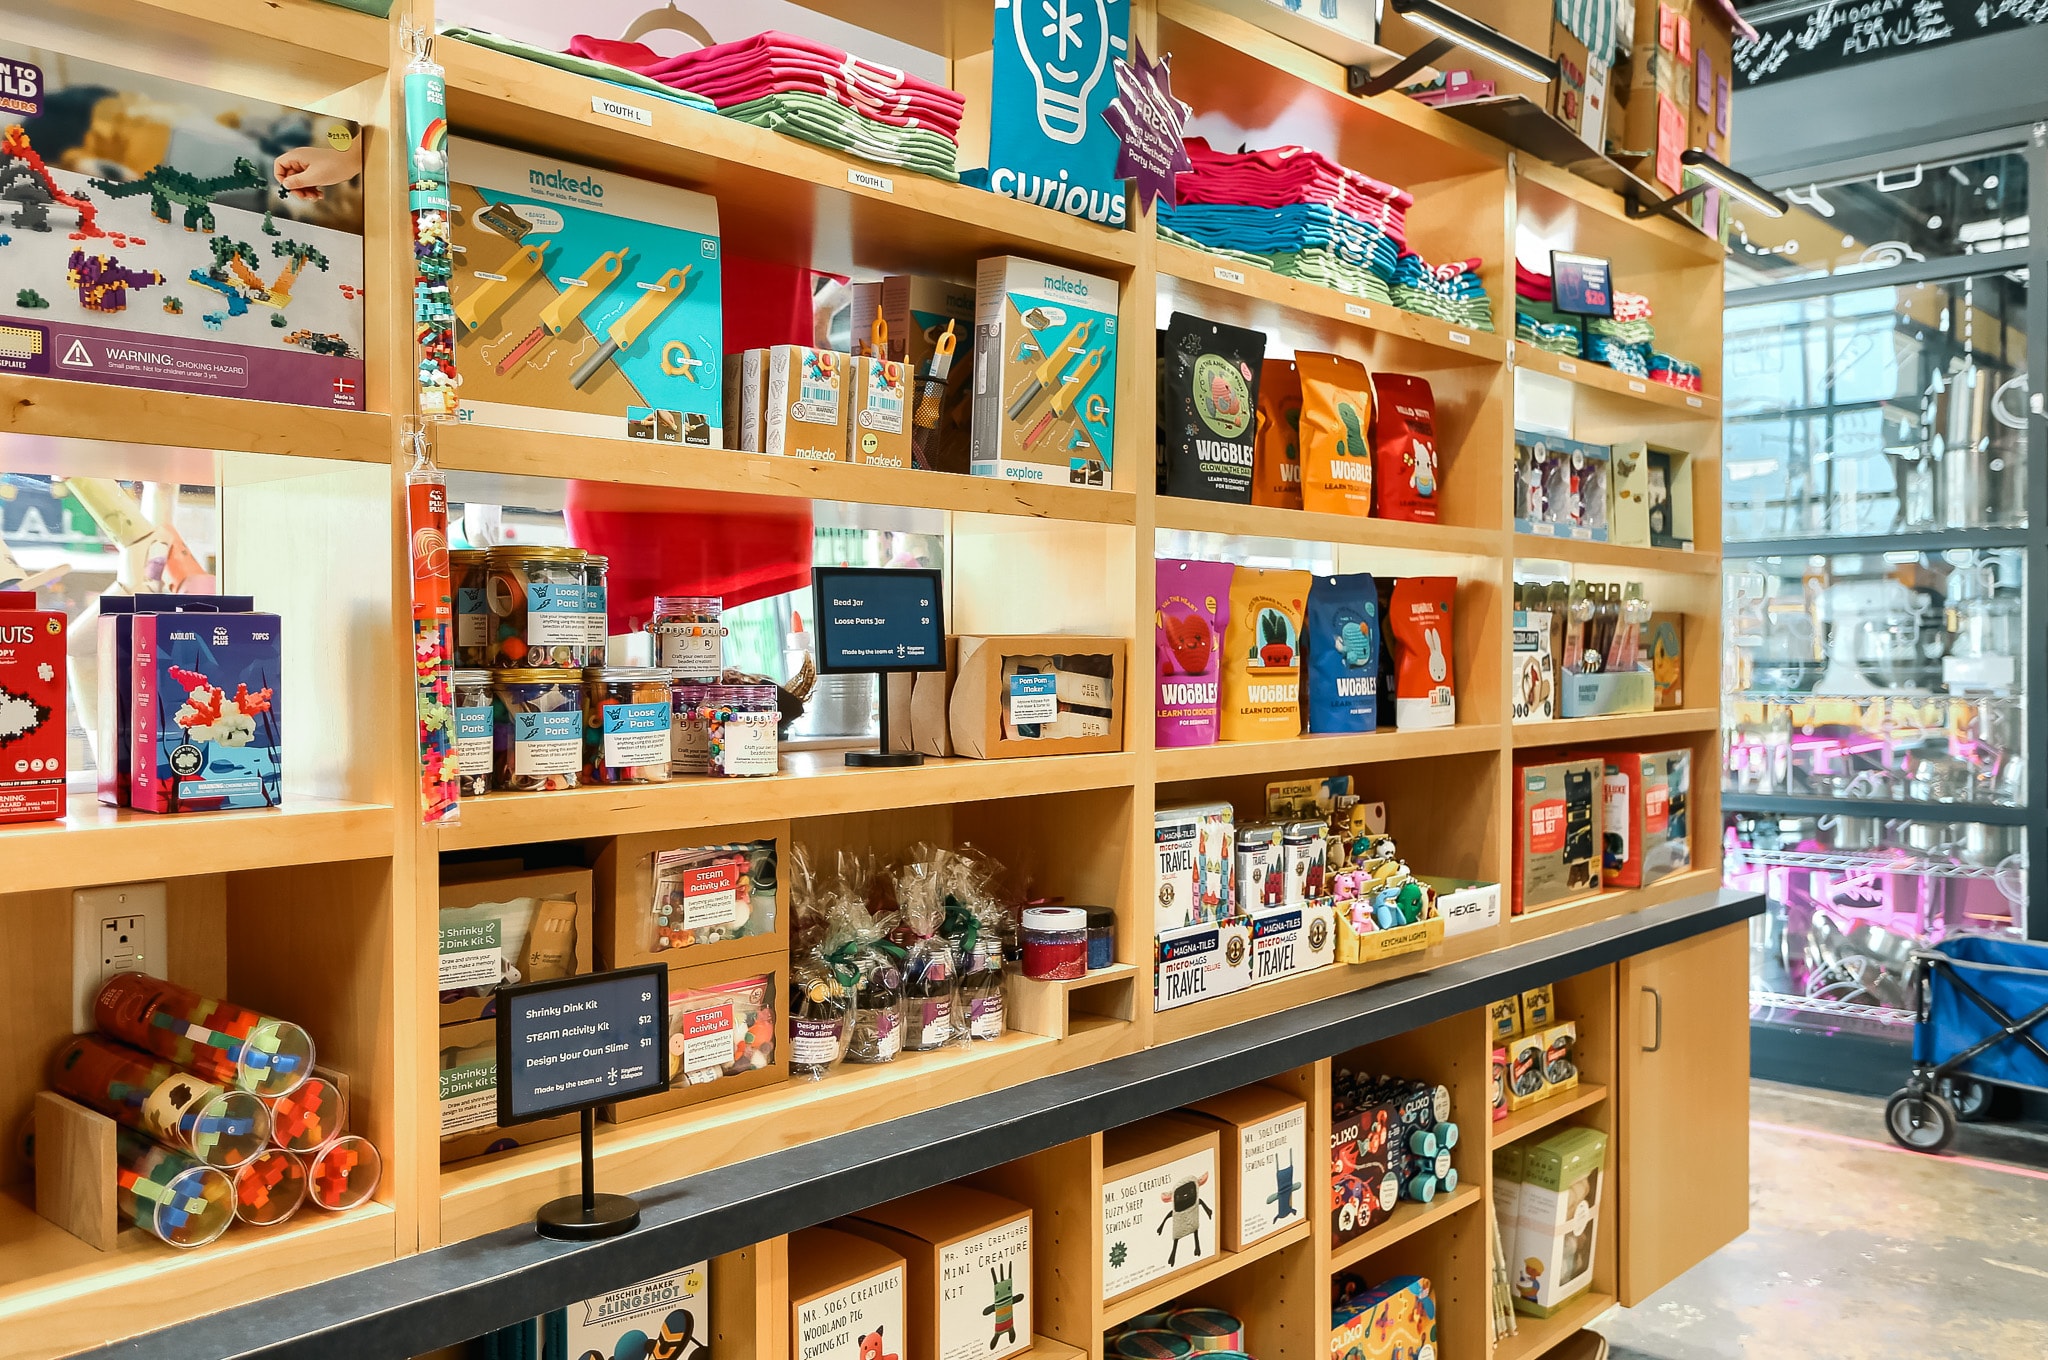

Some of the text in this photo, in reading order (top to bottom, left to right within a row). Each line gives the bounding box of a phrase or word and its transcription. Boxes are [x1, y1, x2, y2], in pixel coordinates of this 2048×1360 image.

[14, 66, 37, 80] TO
[603, 101, 641, 121] YOUTH L
[1128, 148, 1166, 178] Party here!
[529, 169, 604, 198] makedo
[855, 174, 885, 188] YOUTH L
[991, 165, 1127, 226] curious
[1044, 275, 1089, 297] makedo
[1584, 288, 1606, 306] $20
[106, 347, 174, 366] WARNING:
[176, 360, 212, 371] CHOKING
[107, 361, 125, 369] Small
[163, 367, 186, 375] children
[636, 430, 646, 438] cut
[664, 432, 676, 441] fold
[795, 446, 834, 461] makedo
[865, 453, 902, 468] makedo
[1006, 466, 1043, 481] explore
[1324, 482, 1347, 490] LEARN
[555, 587, 579, 597] Loose
[556, 599, 579, 608] Parts
[833, 598, 929, 607] Bead Jar $9
[1180, 597, 1199, 613] HEART
[834, 617, 930, 625] Loose Parts Jar $9
[170, 632, 196, 641] AXOLOTL
[252, 632, 269, 641] 70PCS
[1019, 677, 1033, 685] Pom
[1023, 685, 1044, 693] Maker
[460, 713, 485, 722] Loose
[628, 709, 656, 718] Loose
[1240, 706, 1295, 715] LEARN TO CROCHET
[543, 716, 570, 725] Loose
[630, 720, 655, 729] Parts
[461, 724, 485, 733] Parts
[545, 727, 569, 736] Parts
[1281, 785, 1312, 795] KEYCHAIN
[1163, 829, 1196, 841] MAGNA-TILES
[1159, 849, 1193, 874] TRAVEL
[696, 870, 724, 881] STEAM
[690, 879, 731, 893] Activity Kit
[1449, 902, 1482, 919] HEXEL
[447, 926, 484, 938] Shrinky
[1263, 917, 1302, 935] MAGNA-TILES
[446, 936, 485, 949] Dink Kit
[1380, 930, 1428, 948] KEYCHAIN LIGHTS
[1173, 938, 1216, 957] MAGNA-TILES
[464, 955, 480, 963] shrink
[480, 954, 490, 962] your
[1257, 943, 1296, 978] TRAVEL
[1203, 962, 1222, 973] DELUXE
[1165, 964, 1207, 1001] TRAVEL
[525, 992, 651, 1019] Shrinky Dink Kit $9
[695, 1010, 723, 1023] STEAM
[525, 1015, 652, 1044] STEAM Activity Kit $12
[689, 1018, 730, 1035] Activity Kit
[796, 1021, 835, 1031] Design Your
[798, 1028, 833, 1037] Own Slime
[526, 1038, 652, 1068] Design Your Own Slime $11
[451, 1066, 488, 1082] Shrinky
[451, 1077, 489, 1094] Dink Kit
[534, 1086, 555, 1096] Made
[555, 1083, 565, 1092] by
[565, 1081, 577, 1090] the
[577, 1078, 595, 1087] team
[1405, 1095, 1430, 1113] CLIXO
[1331, 1125, 1360, 1149] CLIXO
[1104, 1198, 1144, 1220] FUZZY SHEEP
[1104, 1213, 1144, 1235] SEWING KIT
[943, 1240, 1029, 1281] MINI CREATURE
[604, 1280, 674, 1304] MISCHIEF MAKER
[824, 1297, 848, 1317] SOGS
[850, 1275, 900, 1306] CREATURES
[943, 1285, 965, 1302] KIT
[598, 1285, 681, 1317] SLINGSHOT
[803, 1308, 863, 1342] WOODLAND PIG
[1330, 1323, 1363, 1352] CLIXO
[803, 1331, 851, 1360] SEWING KIT
